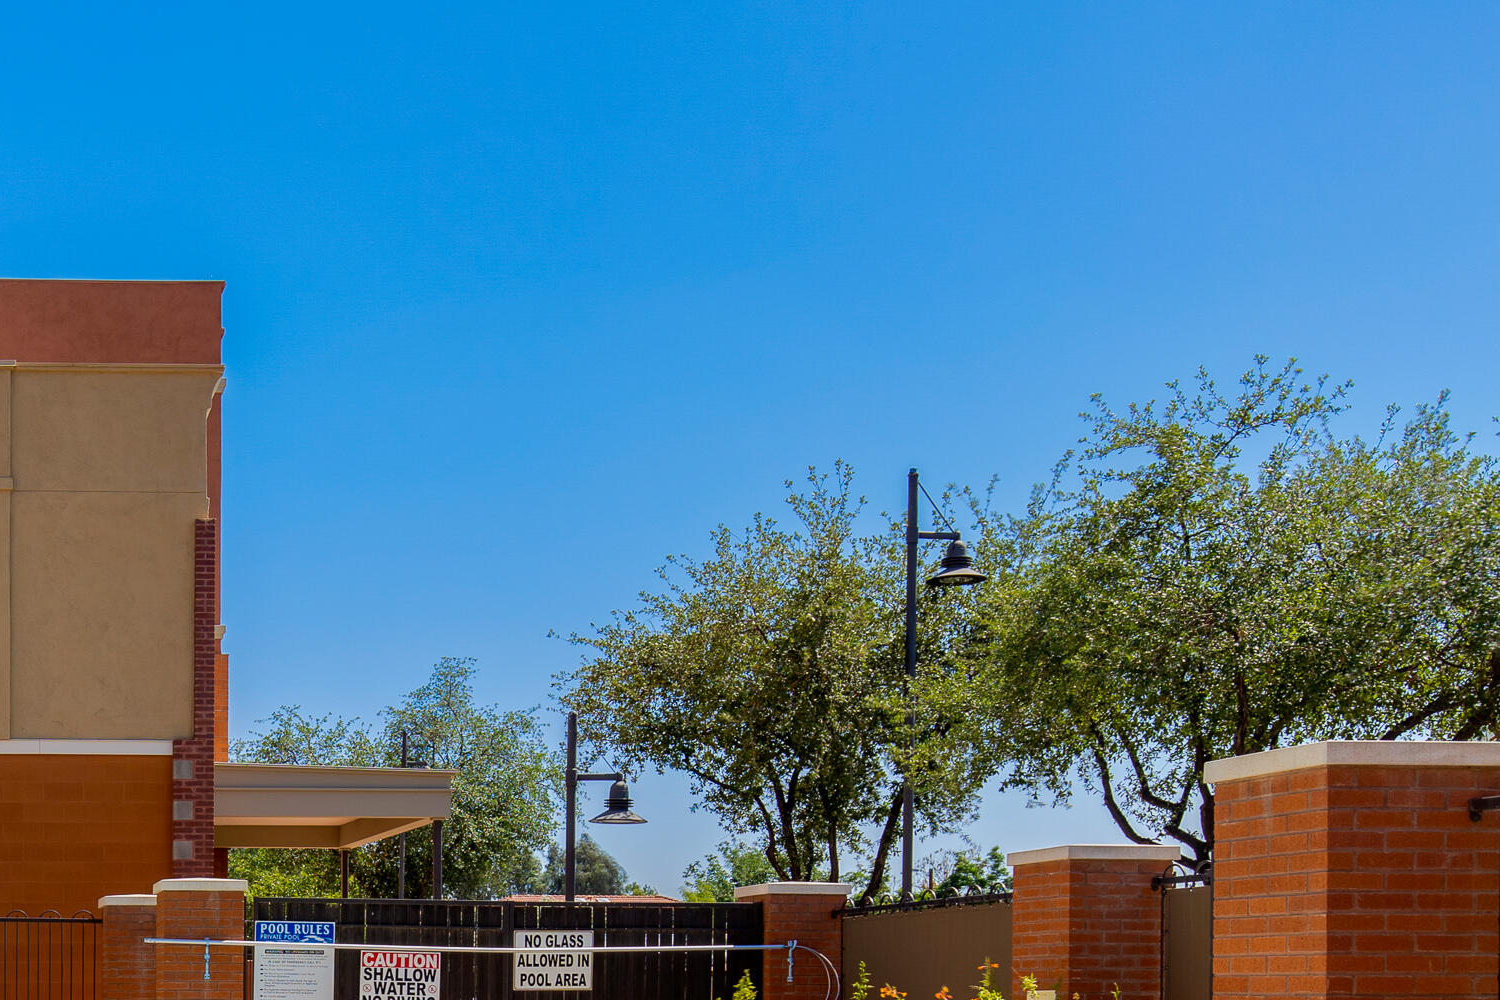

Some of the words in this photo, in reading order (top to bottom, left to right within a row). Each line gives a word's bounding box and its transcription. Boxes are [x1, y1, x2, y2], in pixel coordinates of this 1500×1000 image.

[260, 923, 290, 934] POOL
[294, 924, 330, 935] RULES
[524, 934, 542, 948] NO
[545, 934, 584, 948] GLASS
[363, 952, 438, 968] CAUTION
[517, 953, 574, 968] ALLOWED
[577, 953, 590, 968] IN
[363, 967, 437, 982] SHALLOW
[520, 973, 551, 987] POOL
[554, 973, 587, 987] AREA
[373, 981, 426, 996] WATER
